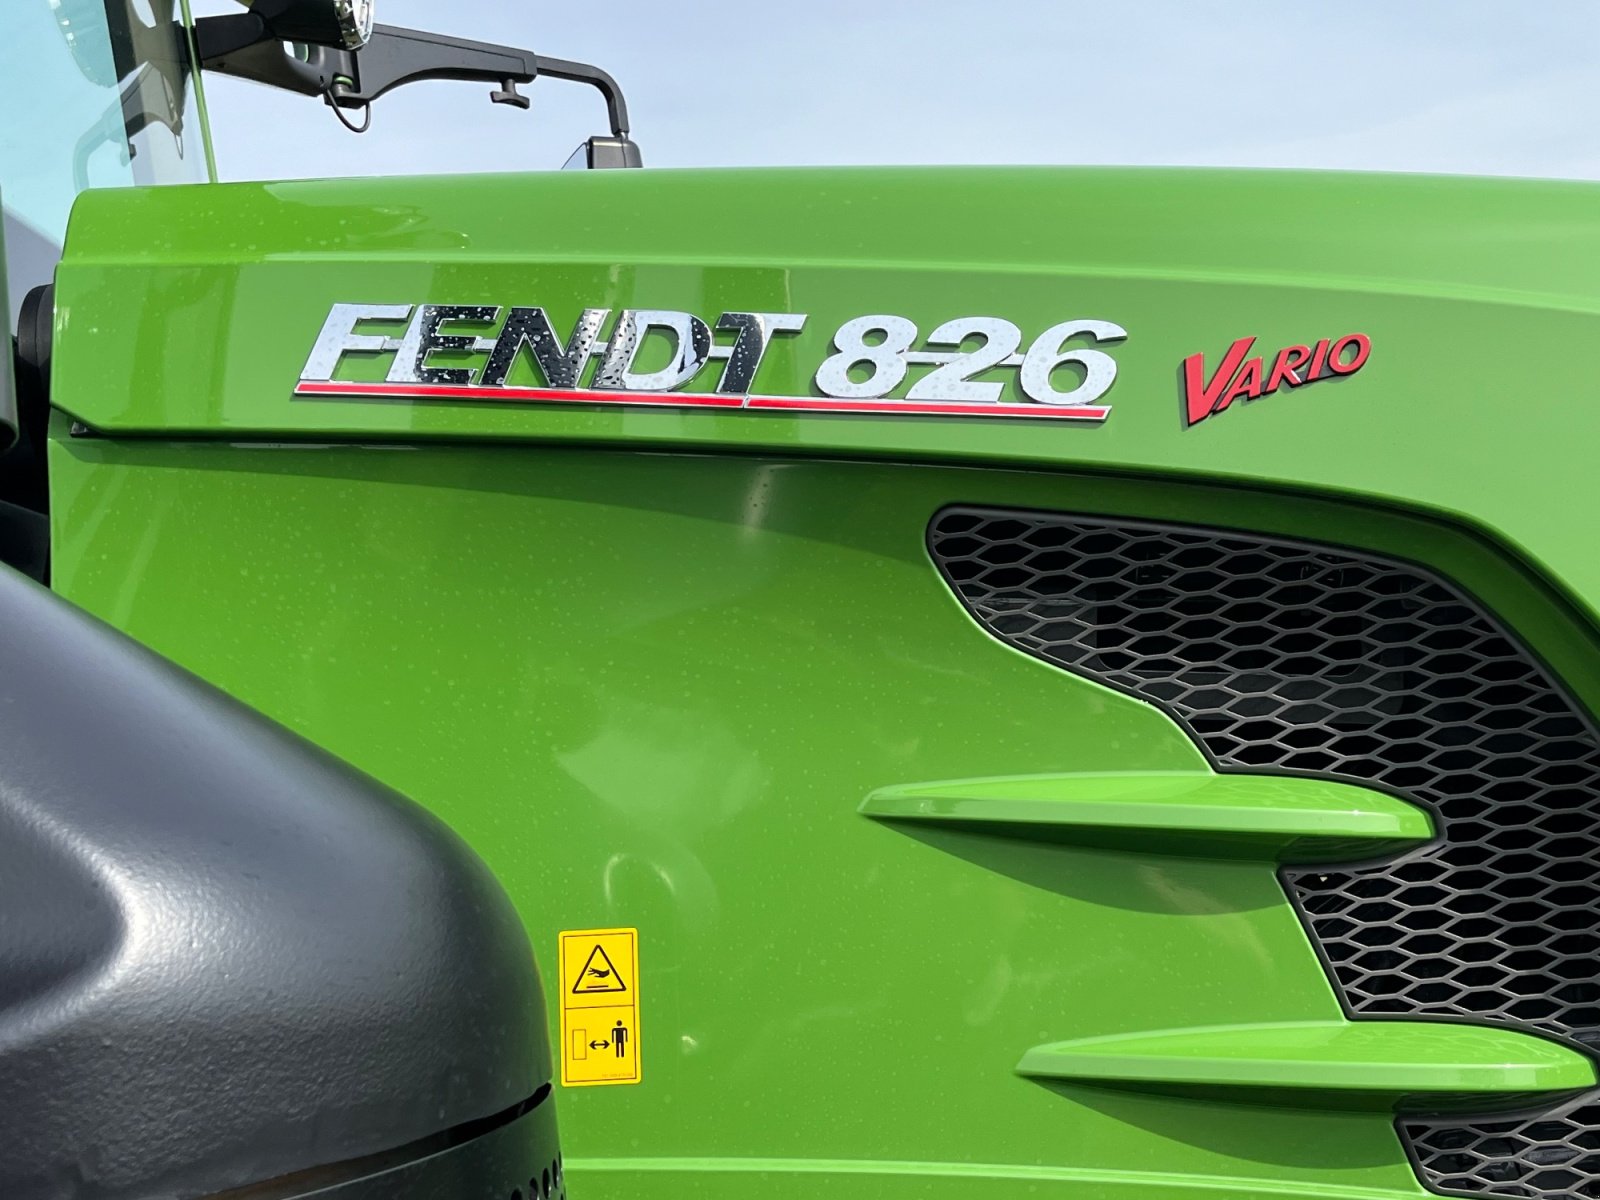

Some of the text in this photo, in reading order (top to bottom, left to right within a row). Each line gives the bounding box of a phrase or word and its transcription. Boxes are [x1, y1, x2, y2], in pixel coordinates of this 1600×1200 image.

[300, 303, 1128, 406] FENDT 826
[1184, 332, 1371, 426] VARIO
